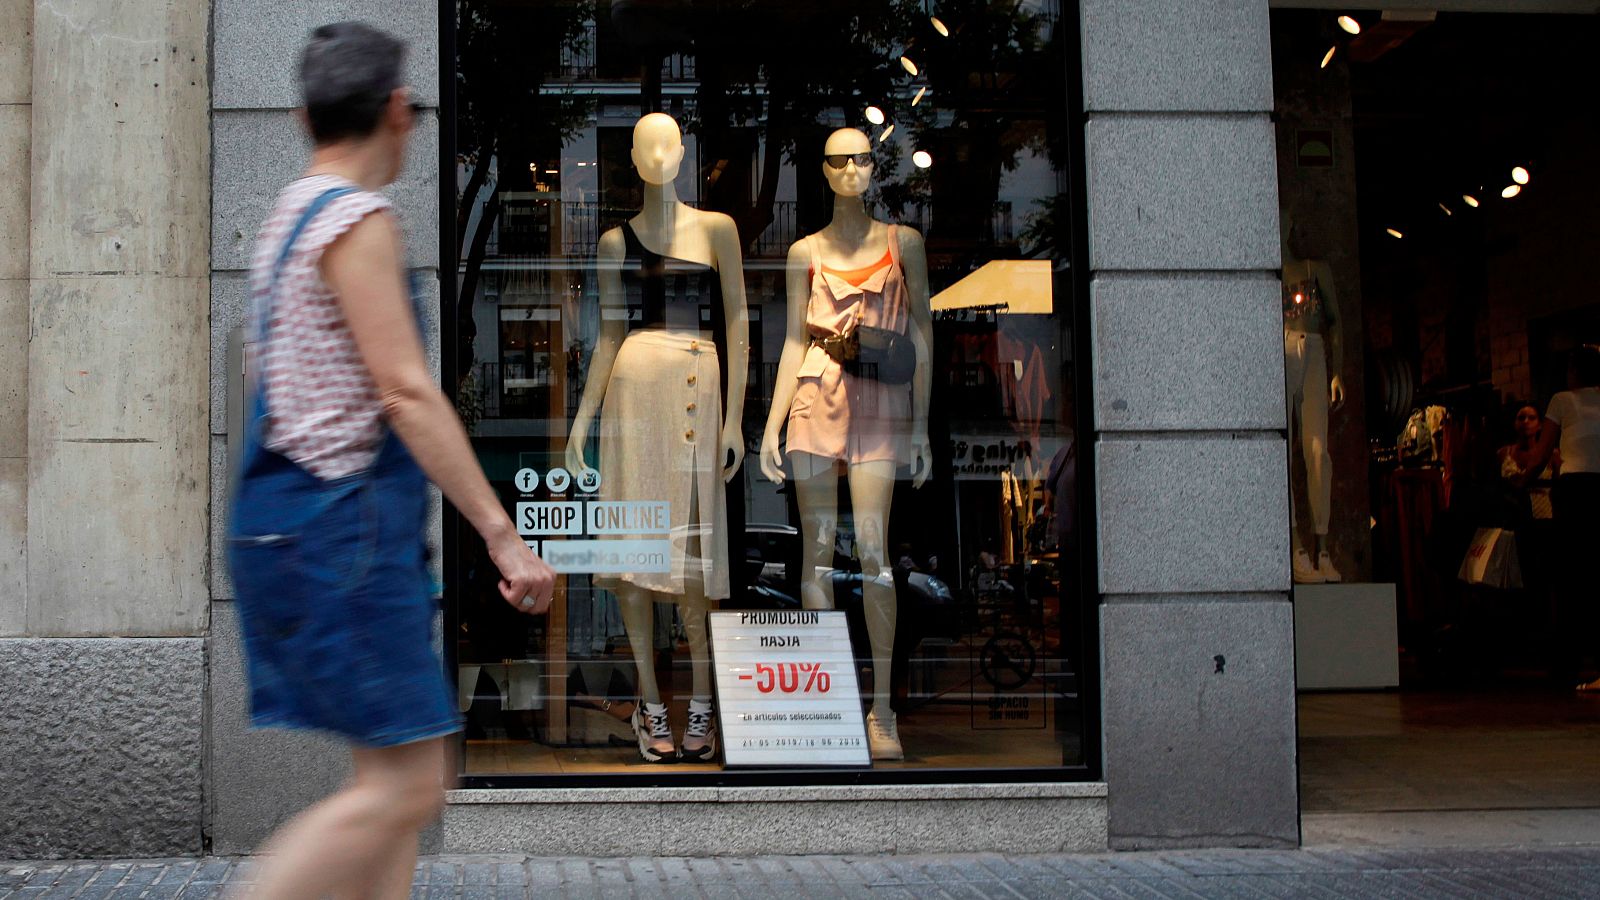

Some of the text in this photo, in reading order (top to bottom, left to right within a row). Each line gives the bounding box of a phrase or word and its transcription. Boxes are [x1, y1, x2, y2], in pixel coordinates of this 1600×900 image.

[524, 506, 664, 530] SHOP ONLINE
[549, 550, 664, 567] bershka.com
[738, 662, 831, 694] -50%
[789, 711, 842, 721] seleccionados
